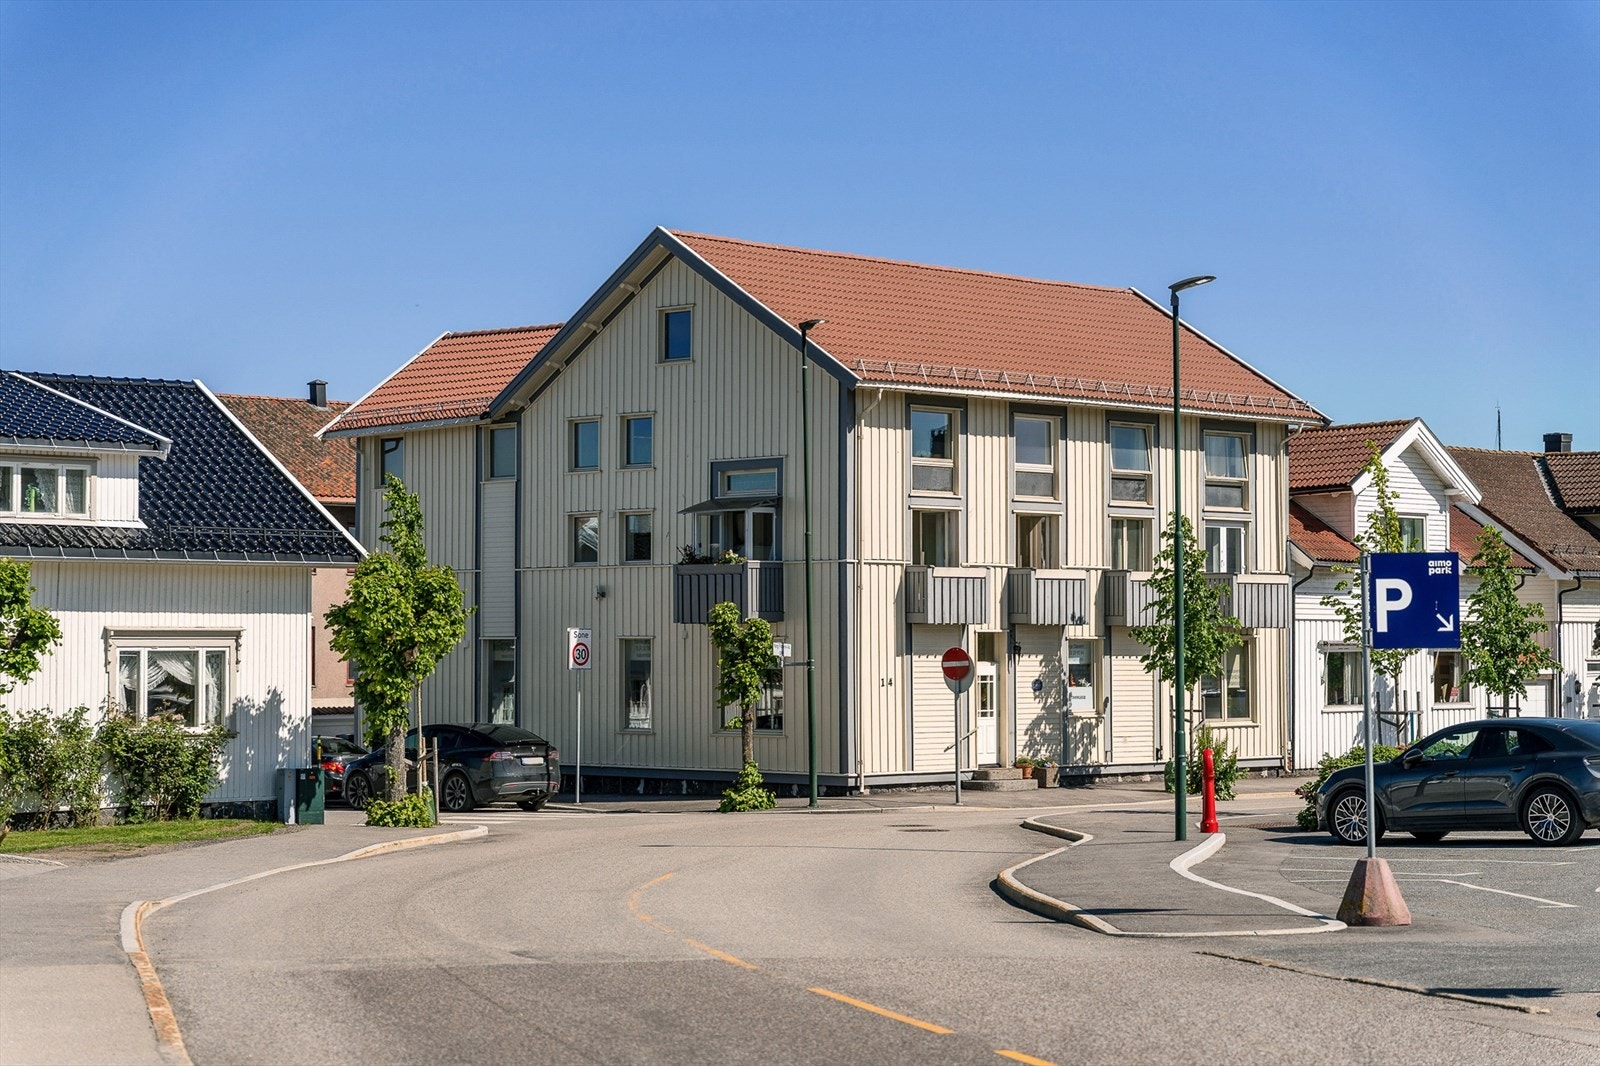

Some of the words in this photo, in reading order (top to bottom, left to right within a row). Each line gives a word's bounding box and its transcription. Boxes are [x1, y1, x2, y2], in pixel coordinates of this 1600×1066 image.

[1428, 567, 1452, 576] park
[1375, 578, 1413, 633] P
[573, 630, 589, 639] Sone
[575, 648, 587, 660] 30
[880, 677, 893, 688] 14
